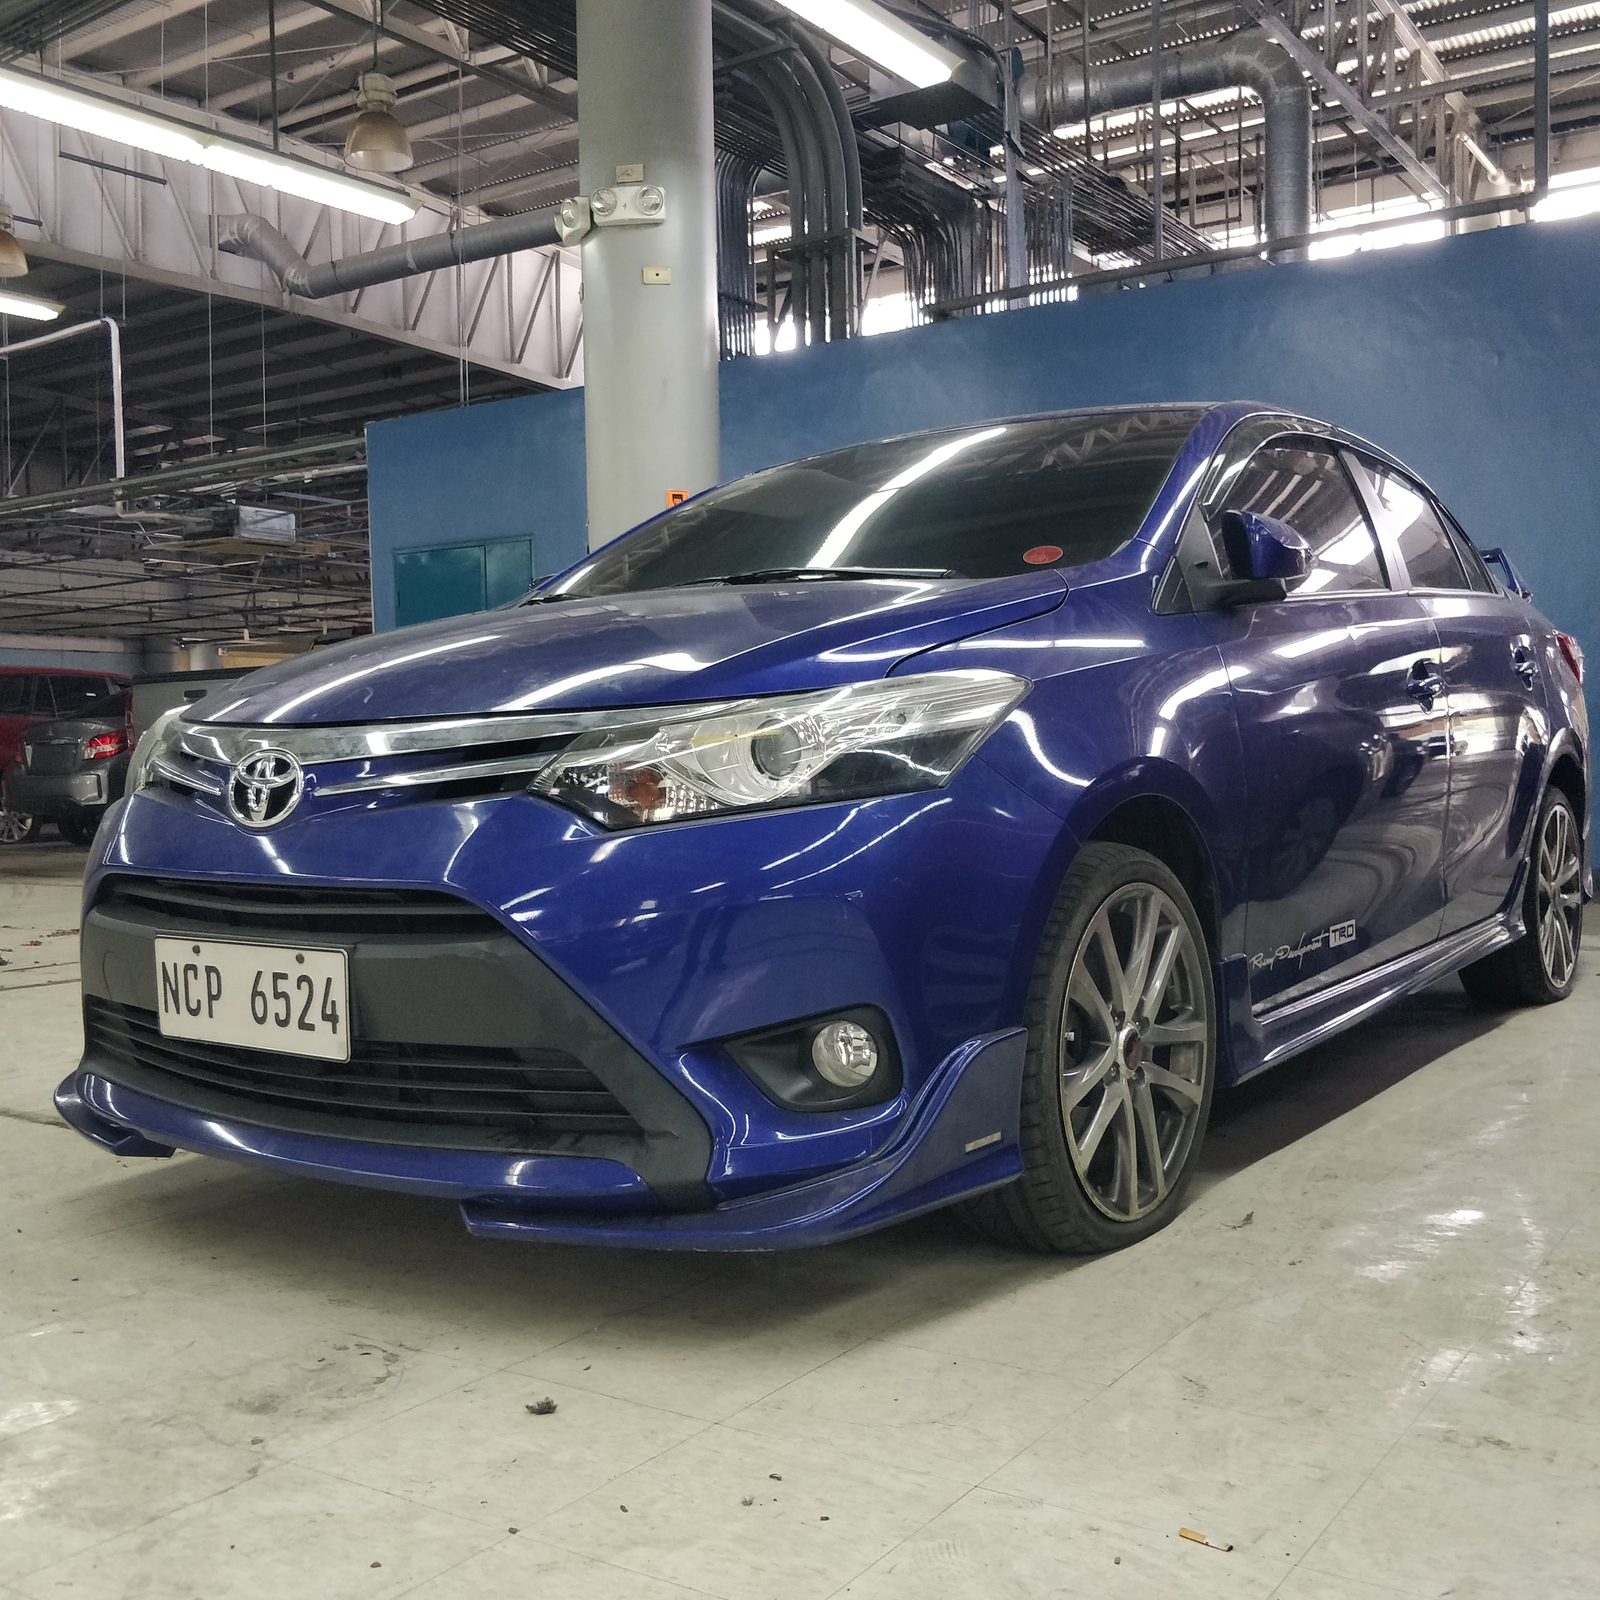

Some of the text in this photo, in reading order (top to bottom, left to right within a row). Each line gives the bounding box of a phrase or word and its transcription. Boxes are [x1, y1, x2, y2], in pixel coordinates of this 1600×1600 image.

[1331, 923, 1355, 943] TRD
[161, 961, 340, 1035] NCP 6524
